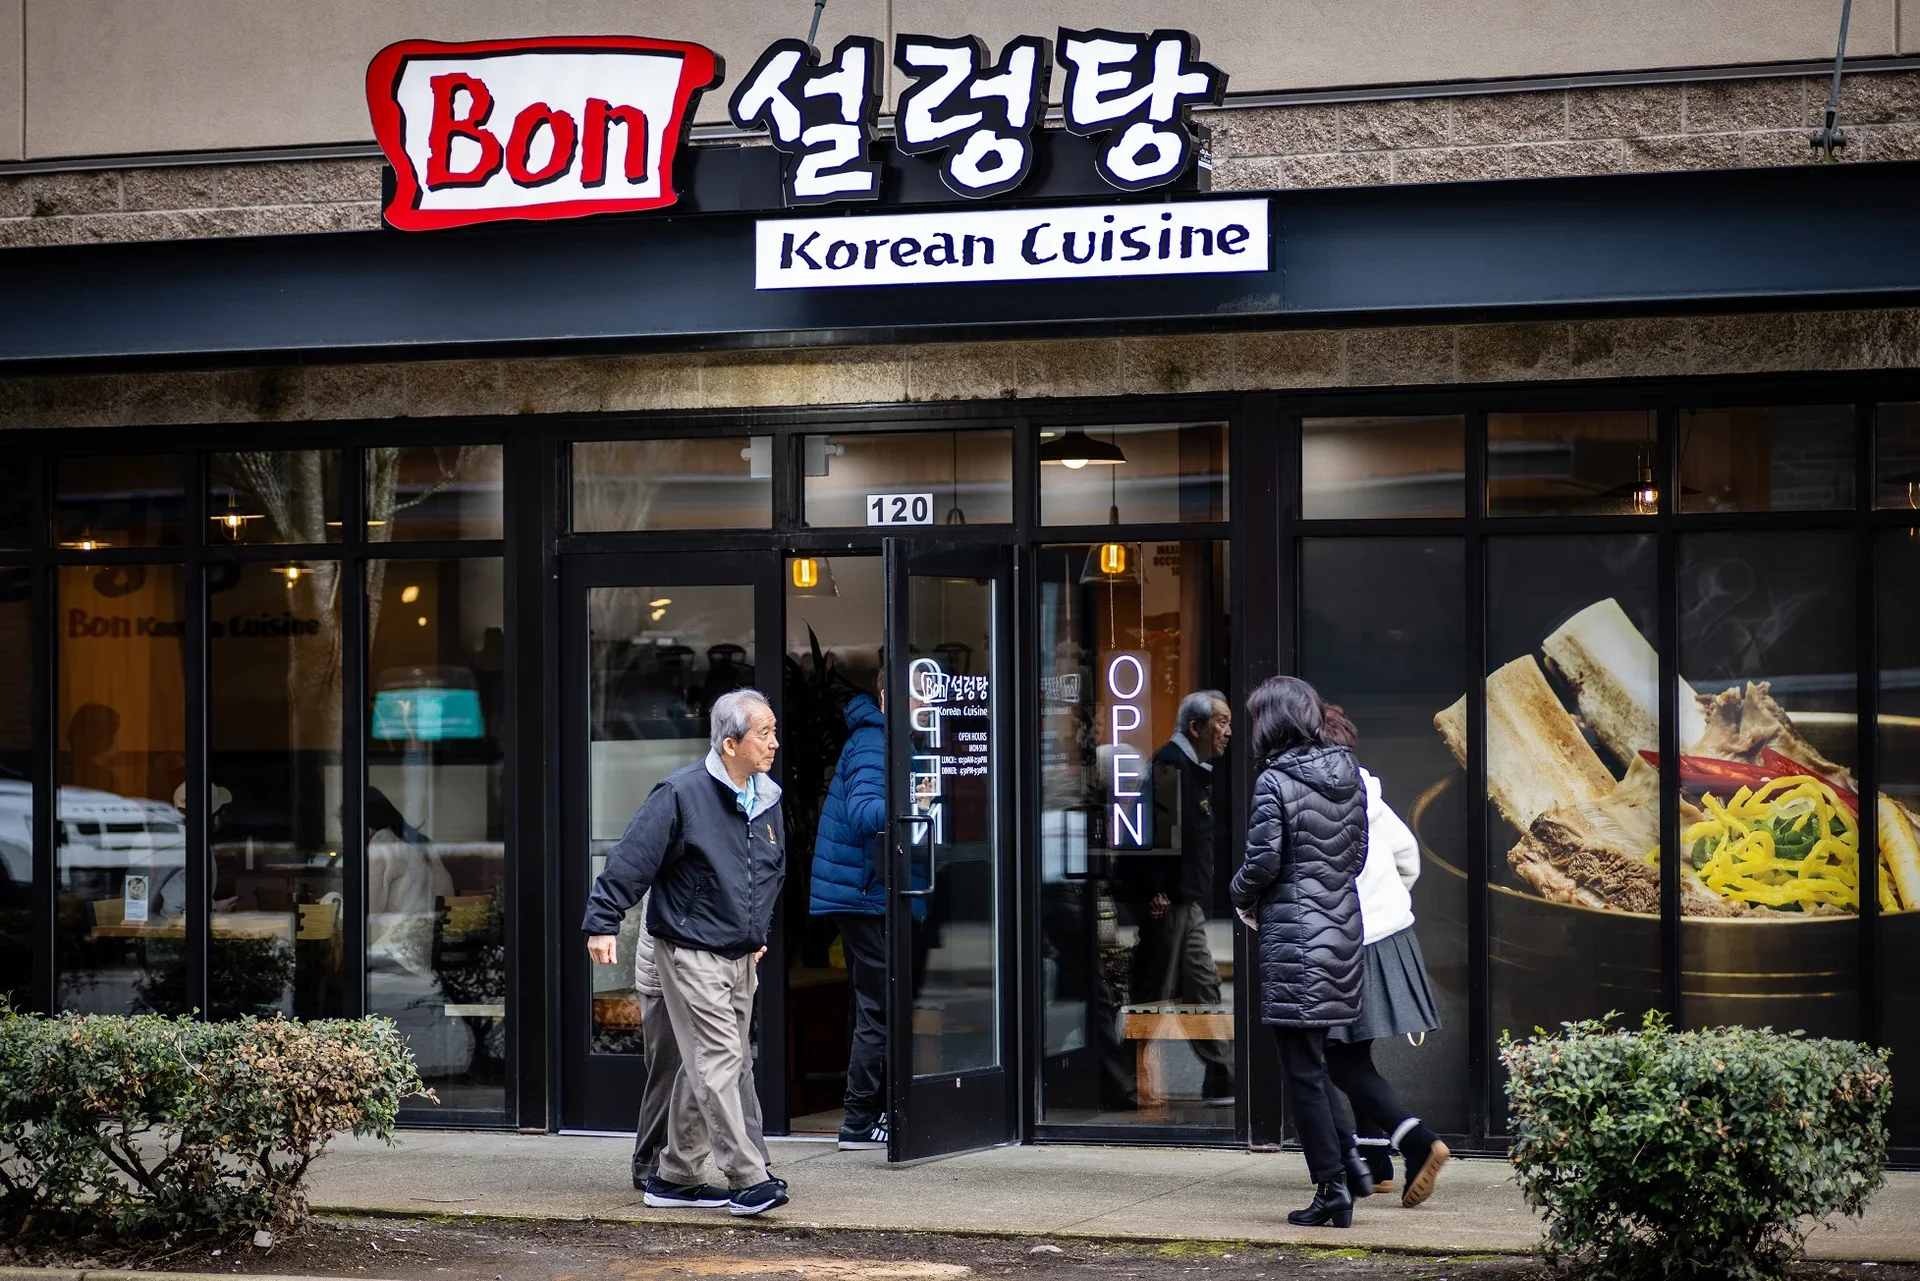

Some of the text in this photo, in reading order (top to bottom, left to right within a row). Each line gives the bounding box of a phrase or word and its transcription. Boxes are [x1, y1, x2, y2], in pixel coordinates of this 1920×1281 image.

[426, 73, 648, 191] Bon
[738, 39, 1208, 197] 설렁탕
[780, 212, 1251, 270] Korean Cuisine
[872, 496, 928, 523] 120
[69, 608, 131, 638] Bon
[229, 610, 321, 637] Cuisine
[951, 675, 989, 701] 설렁탕
[938, 705, 988, 716] Korean Cuisine
[1108, 655, 1145, 846] OPEN
